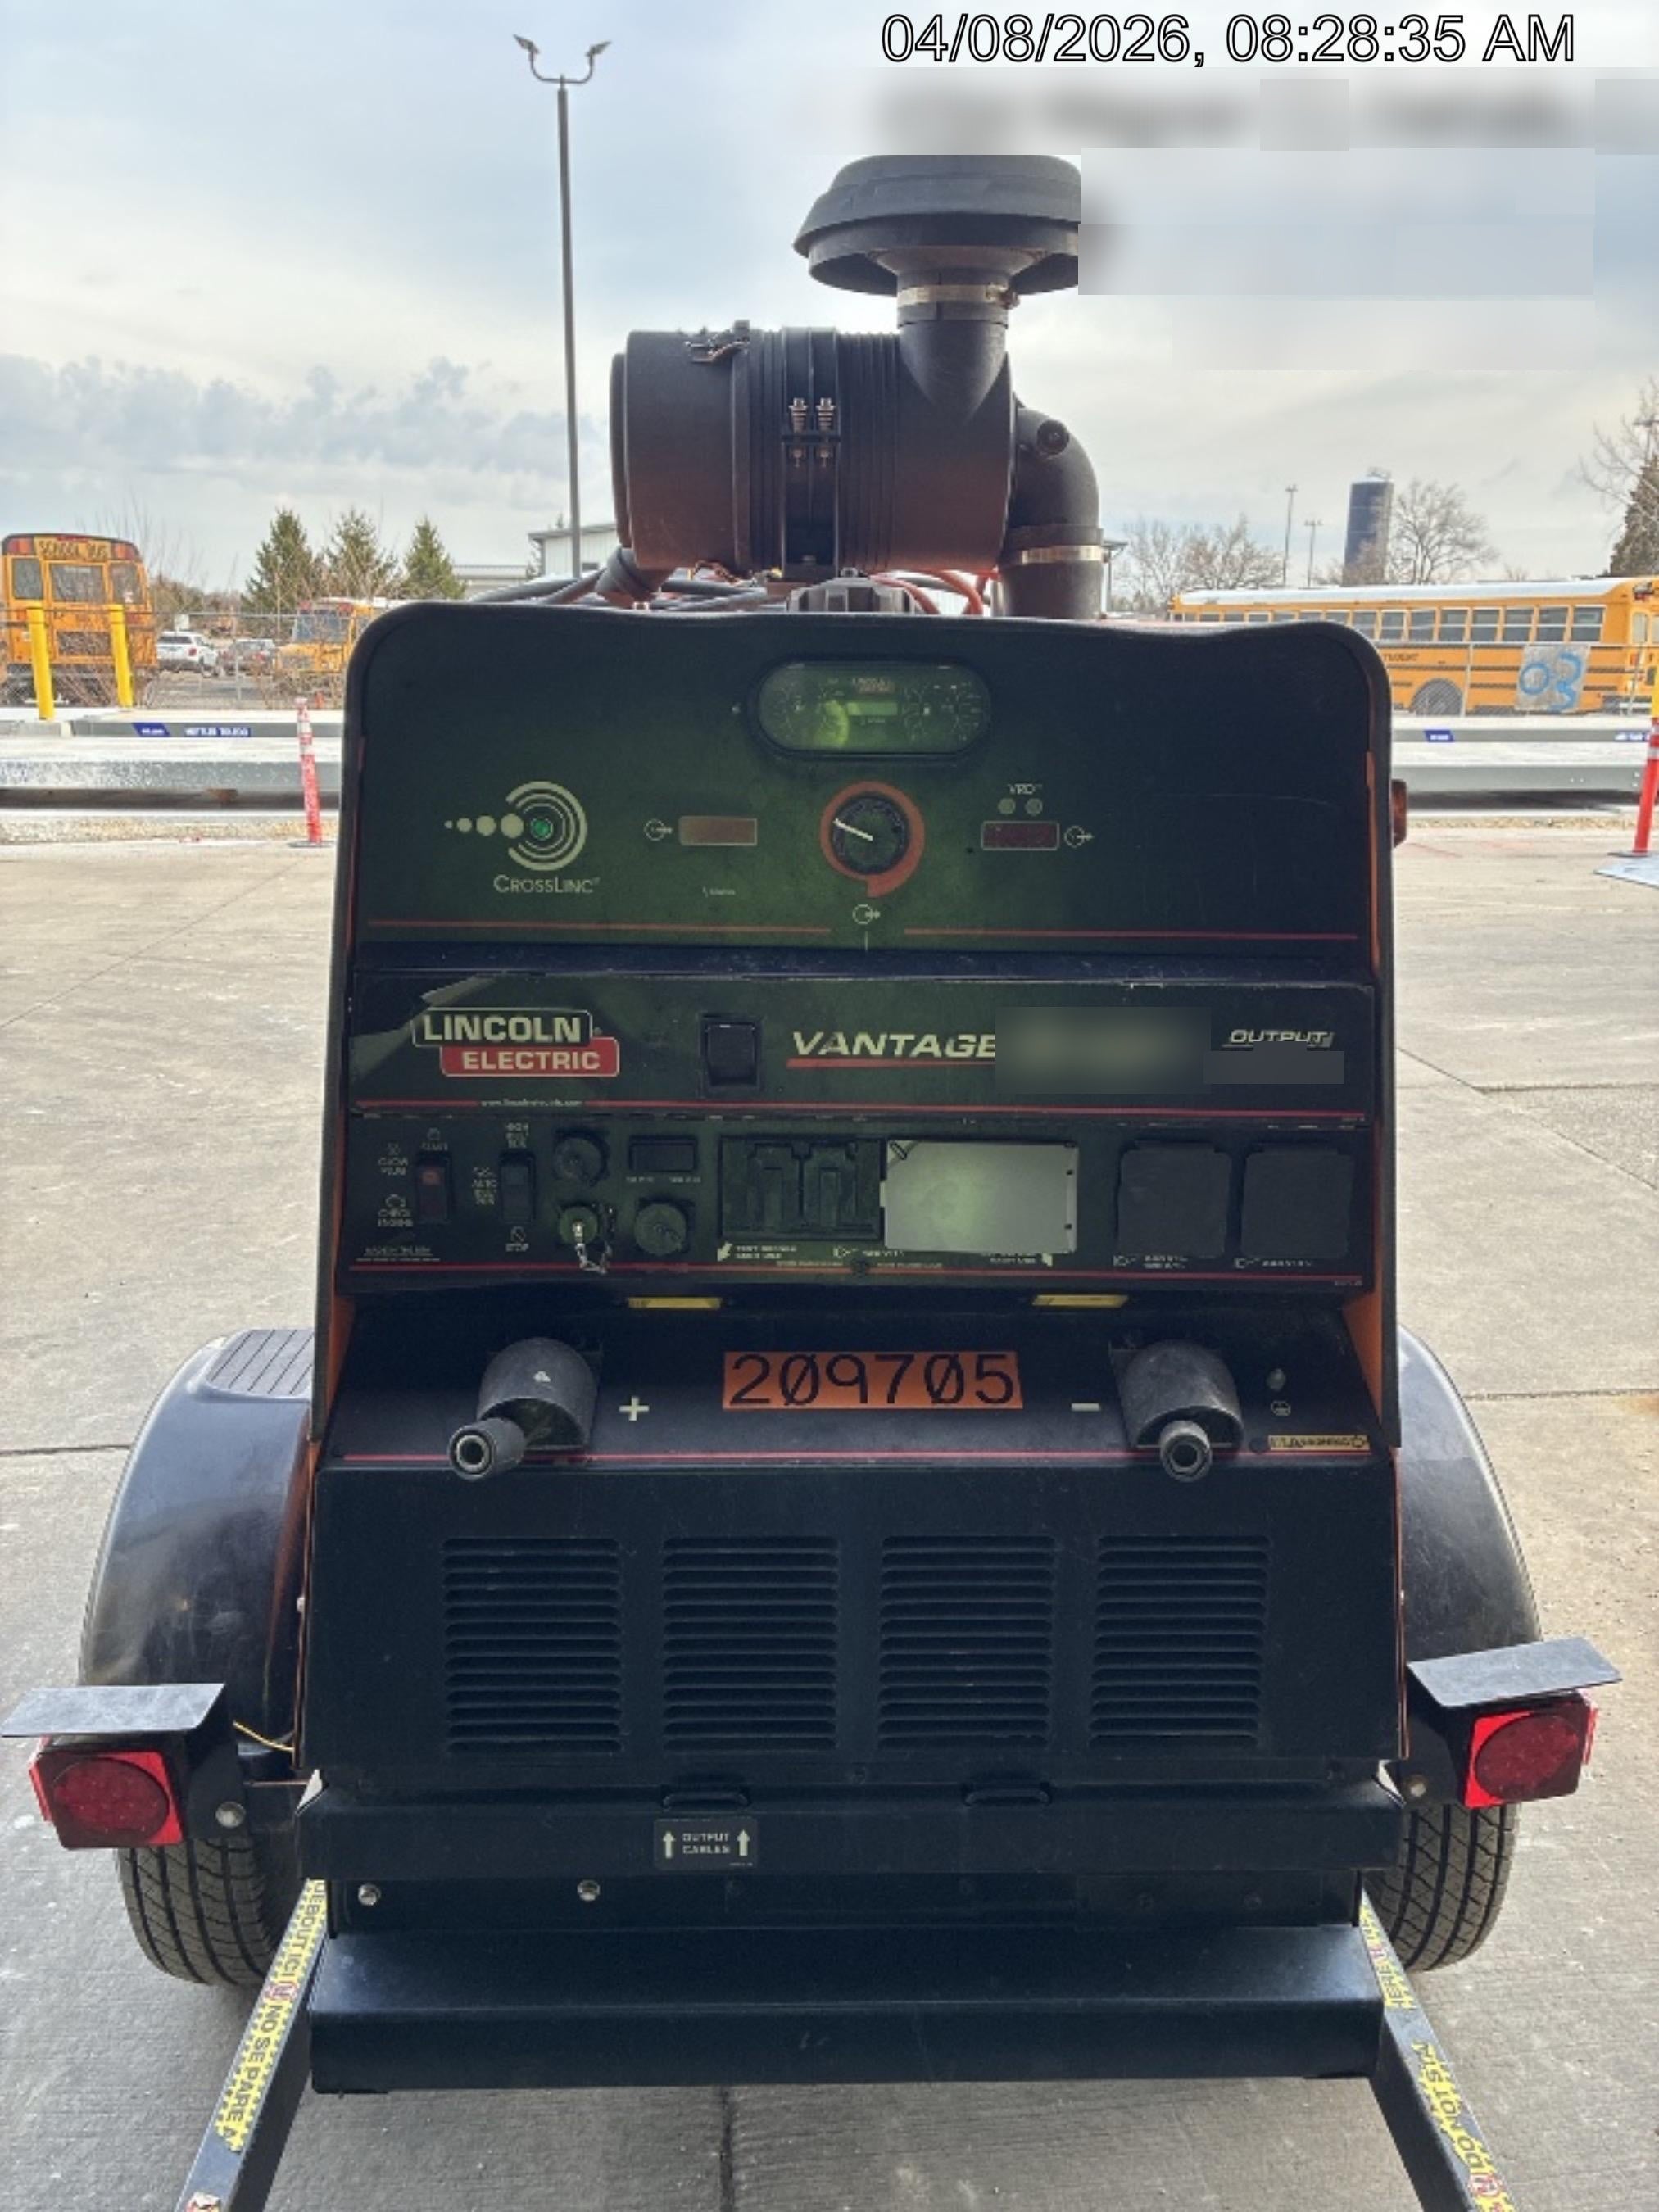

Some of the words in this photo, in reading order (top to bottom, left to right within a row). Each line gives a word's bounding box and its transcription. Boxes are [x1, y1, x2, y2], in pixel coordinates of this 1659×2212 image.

[424, 1014, 580, 1043] LINCOLN
[792, 1031, 995, 1058] VANTAGE
[1230, 1029, 1329, 1043] OUTPUT
[462, 1050, 600, 1071] ELECTRIC
[682, 1833, 729, 1843] OUTPUT
[682, 1845, 730, 1855] CABLES
